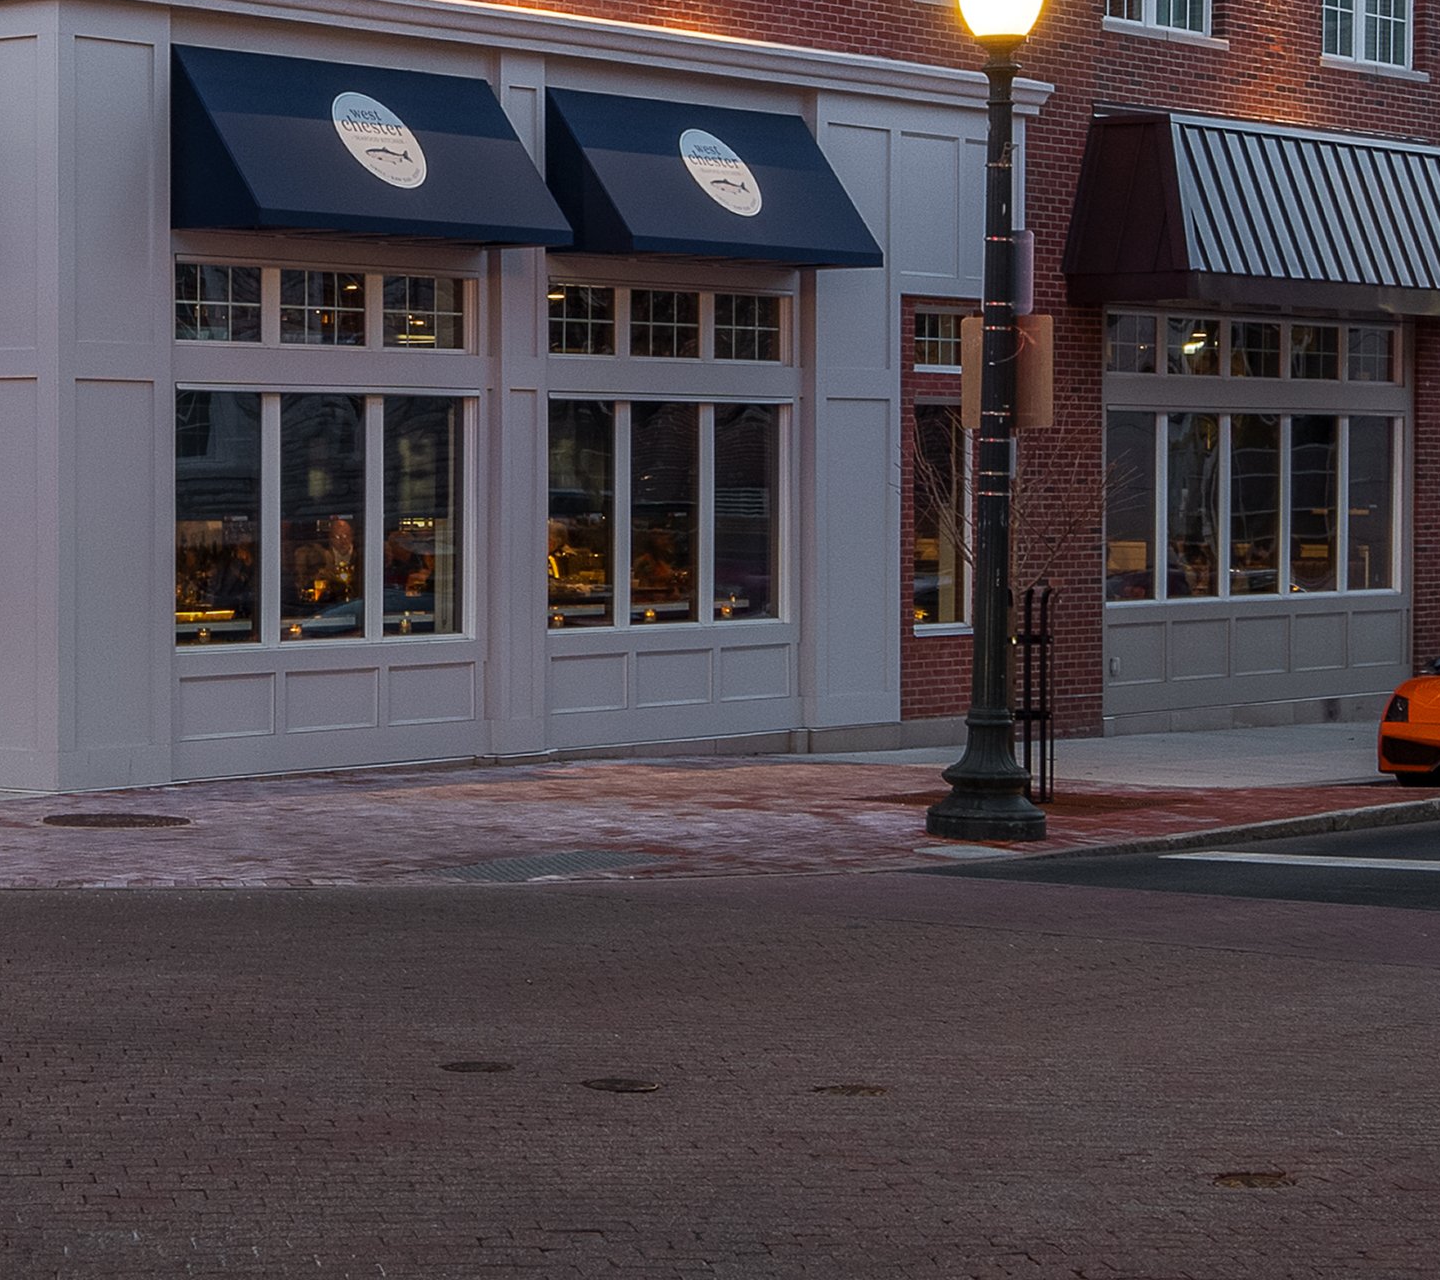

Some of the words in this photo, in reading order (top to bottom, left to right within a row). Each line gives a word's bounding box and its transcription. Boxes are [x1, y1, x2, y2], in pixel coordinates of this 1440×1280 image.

[348, 108, 382, 121] west
[340, 114, 403, 137] chester
[693, 143, 722, 156] west
[687, 149, 740, 170] chester
